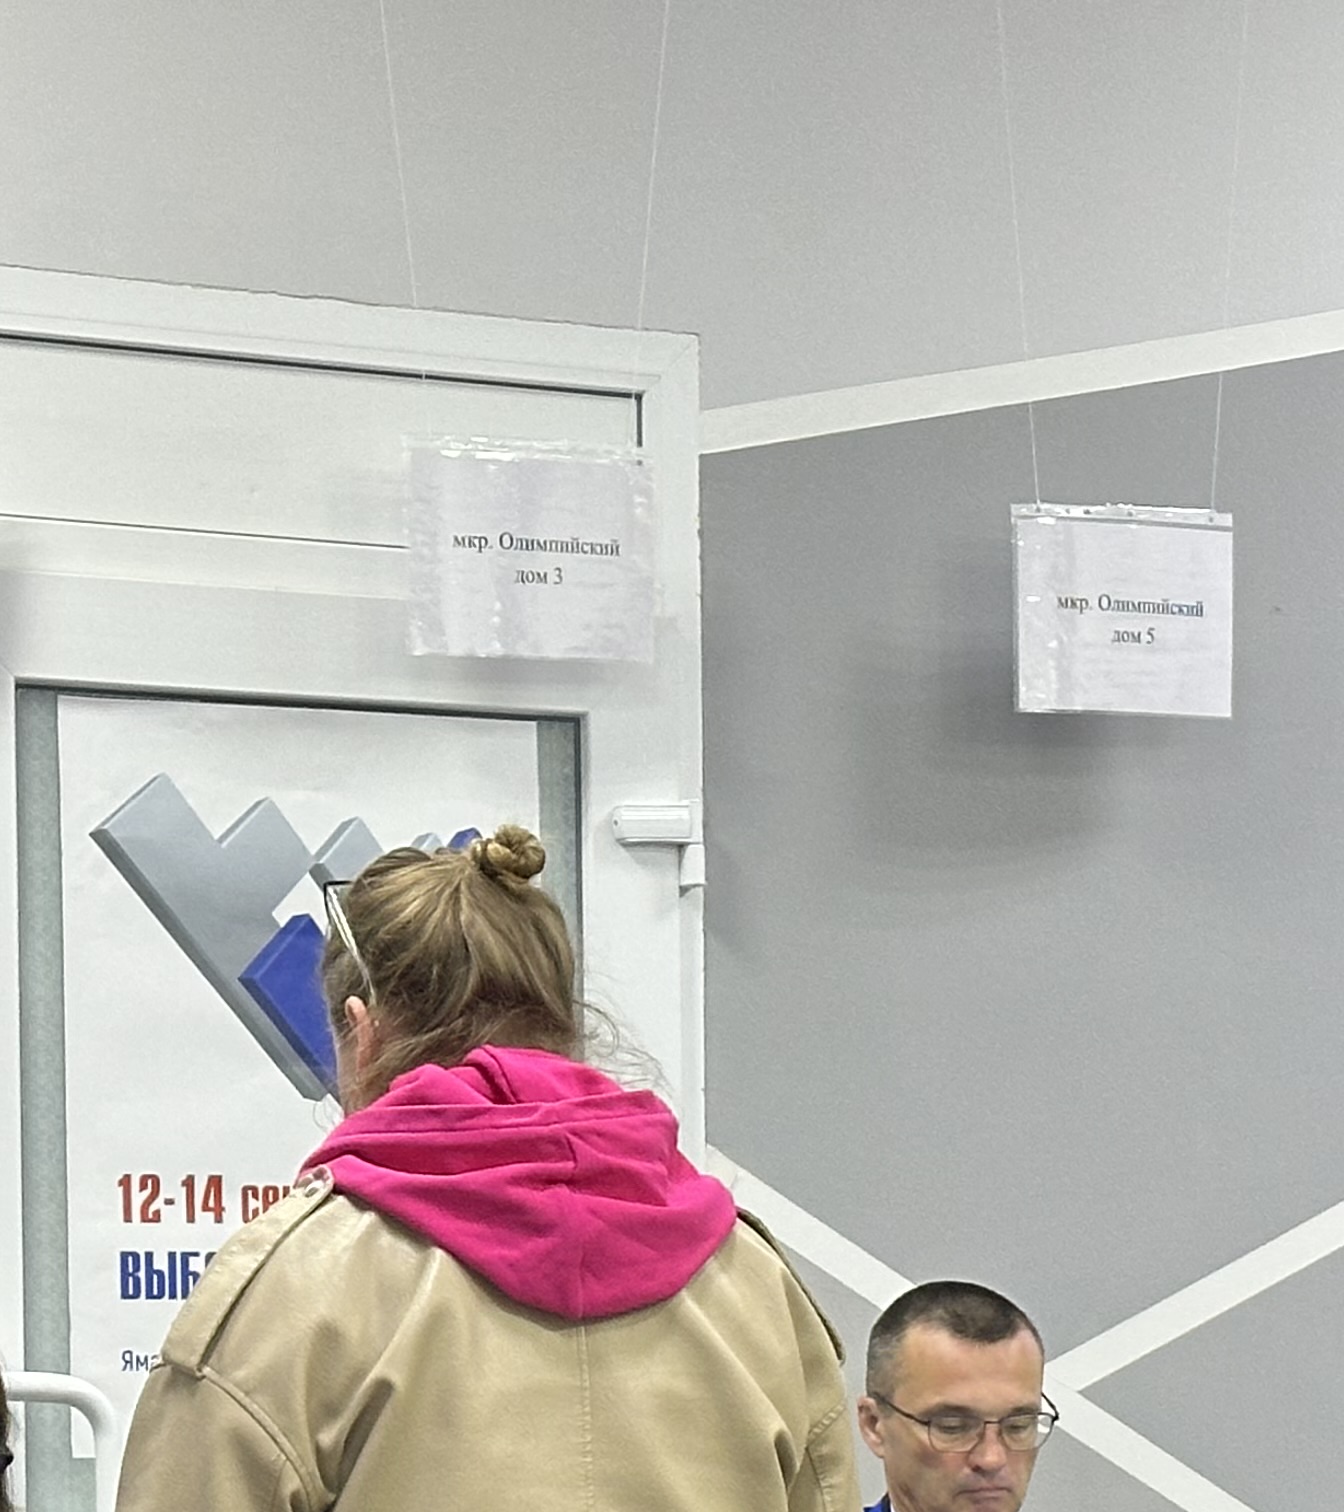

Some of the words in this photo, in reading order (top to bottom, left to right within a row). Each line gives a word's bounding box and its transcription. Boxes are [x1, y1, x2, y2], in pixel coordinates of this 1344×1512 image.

[452, 534, 493, 553] мкр.
[499, 531, 621, 557] Олимпийский
[514, 569, 548, 585] дом
[553, 567, 563, 585] 3
[1057, 595, 1093, 616] мкр.
[1098, 593, 1204, 618] Олимпийский
[1111, 629, 1142, 644] дом
[1146, 627, 1155, 645] 5
[118, 1173, 226, 1224] 12-14
[119, 1250, 216, 1301] ВЫБ
